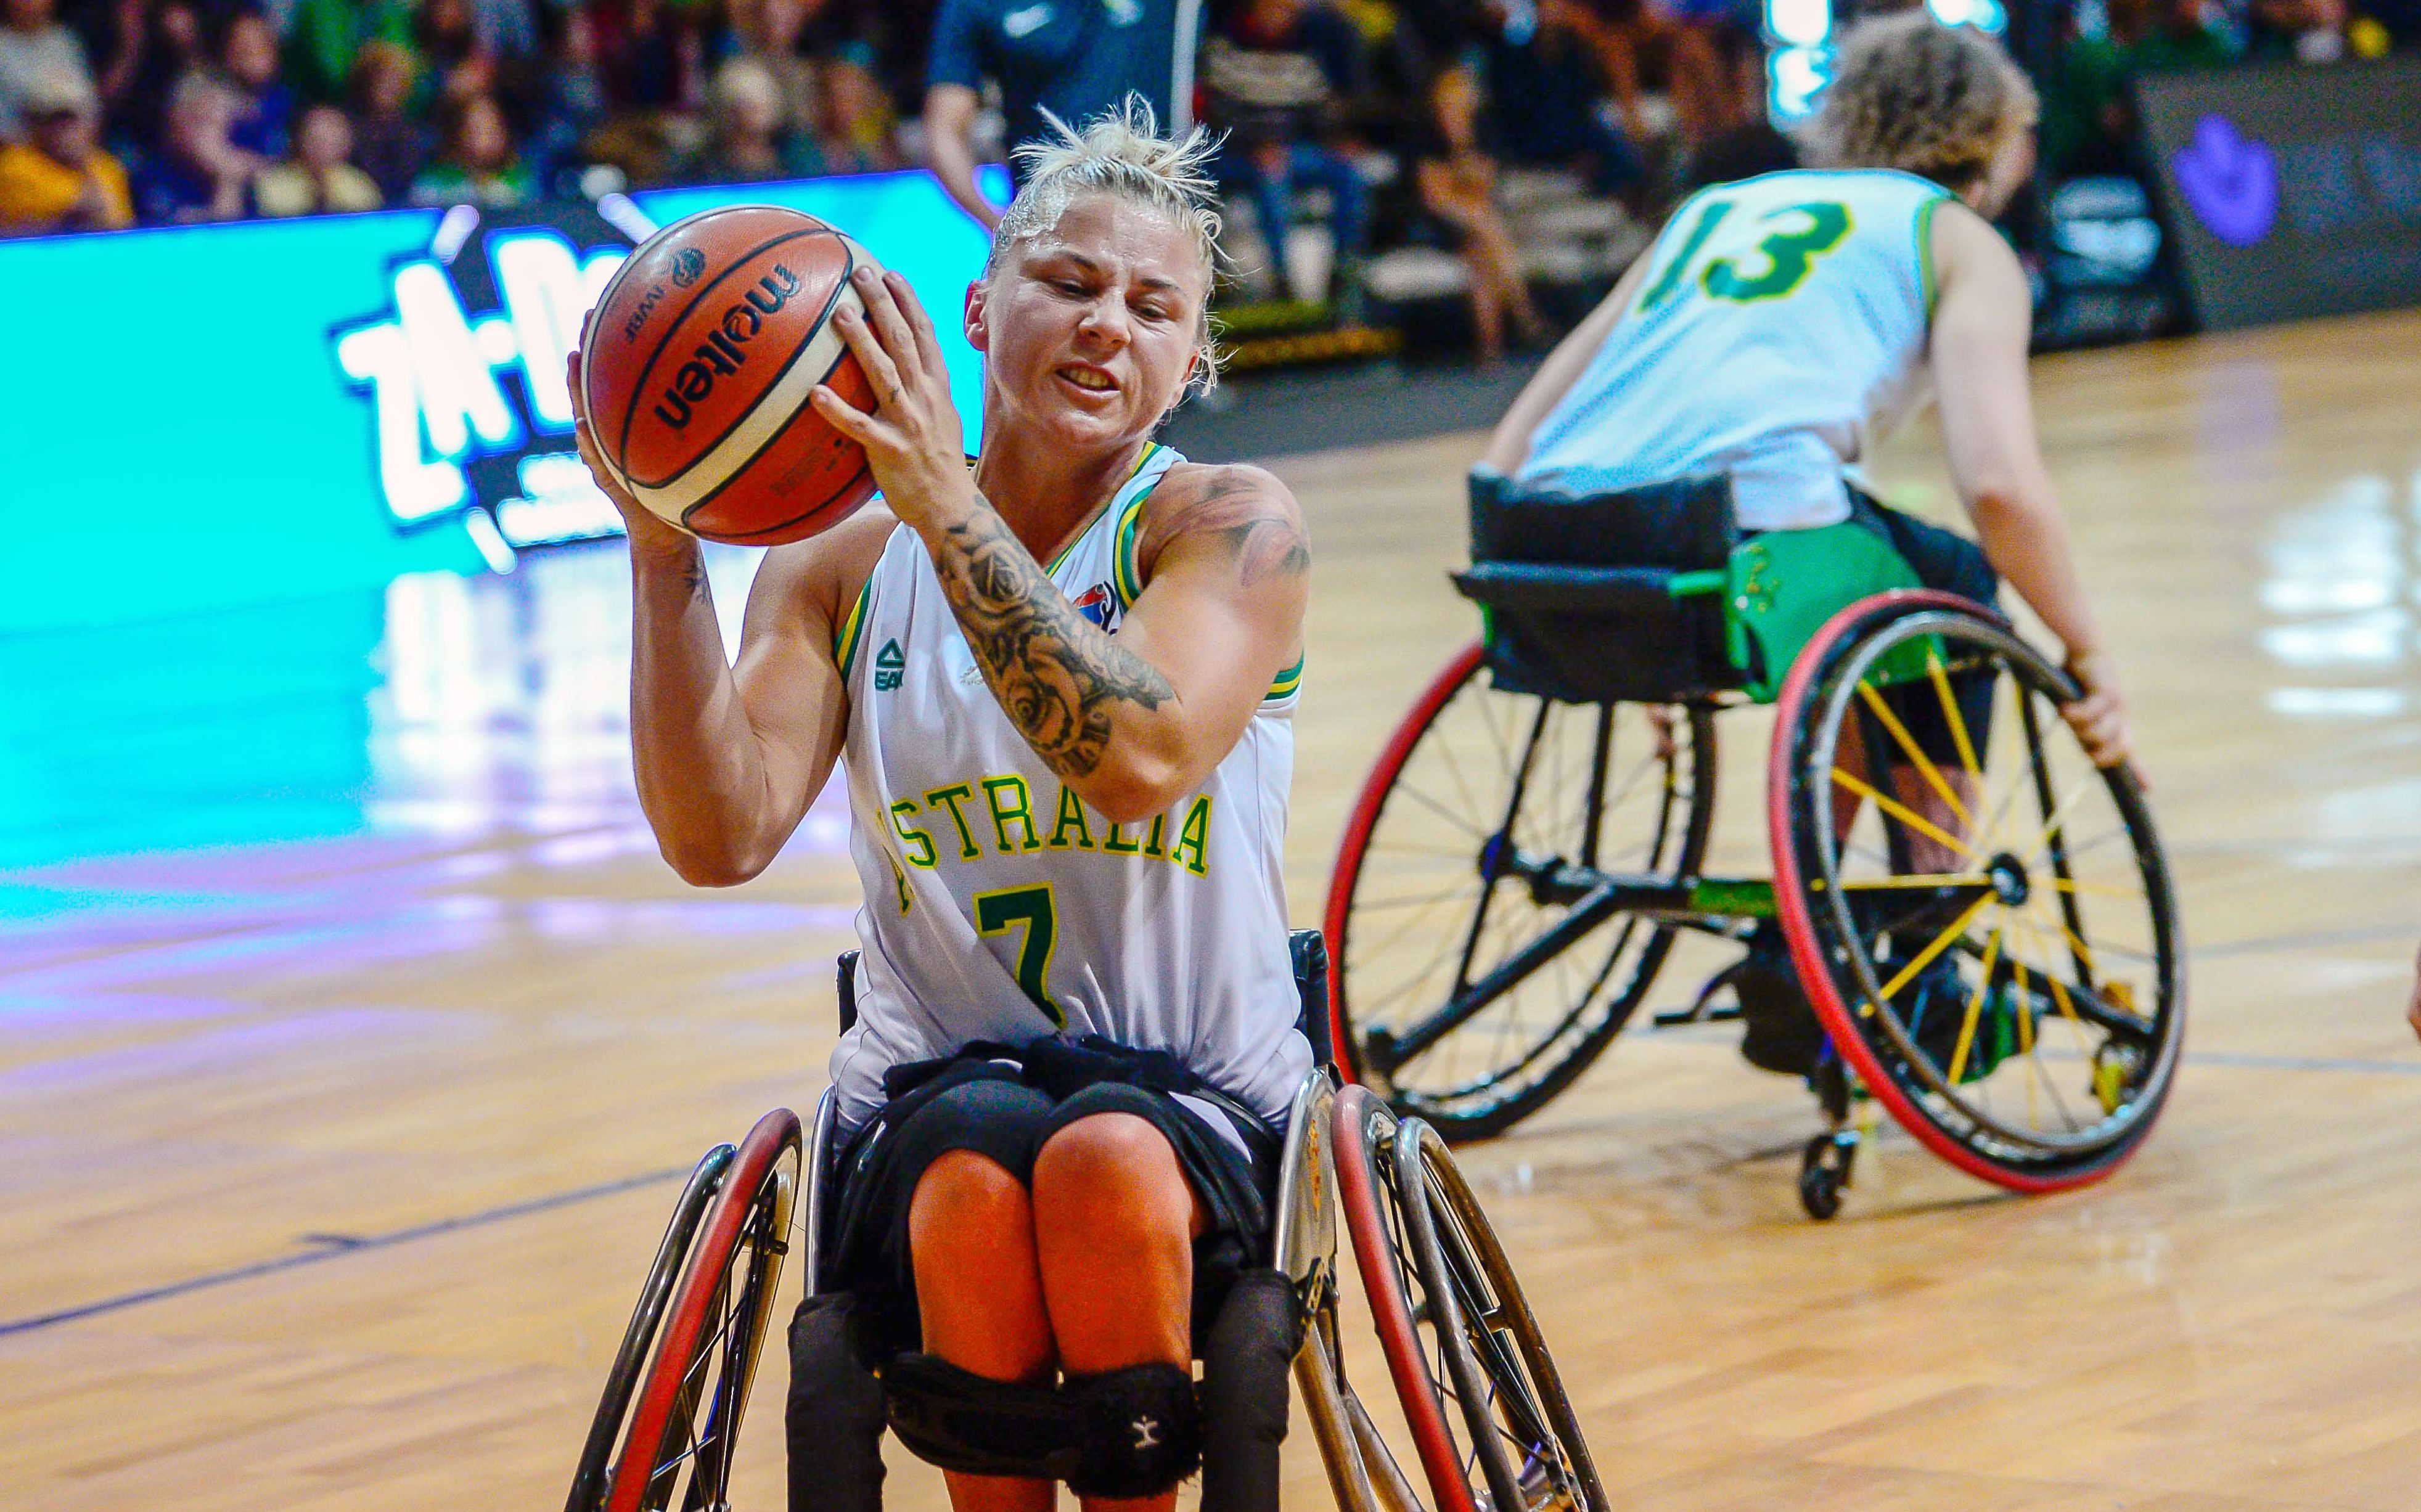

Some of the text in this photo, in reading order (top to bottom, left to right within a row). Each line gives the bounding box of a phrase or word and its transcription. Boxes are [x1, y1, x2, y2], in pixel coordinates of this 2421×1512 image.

[1637, 200, 1854, 314] 13
[654, 263, 801, 428] molten
[972, 880, 1068, 1030] 7
